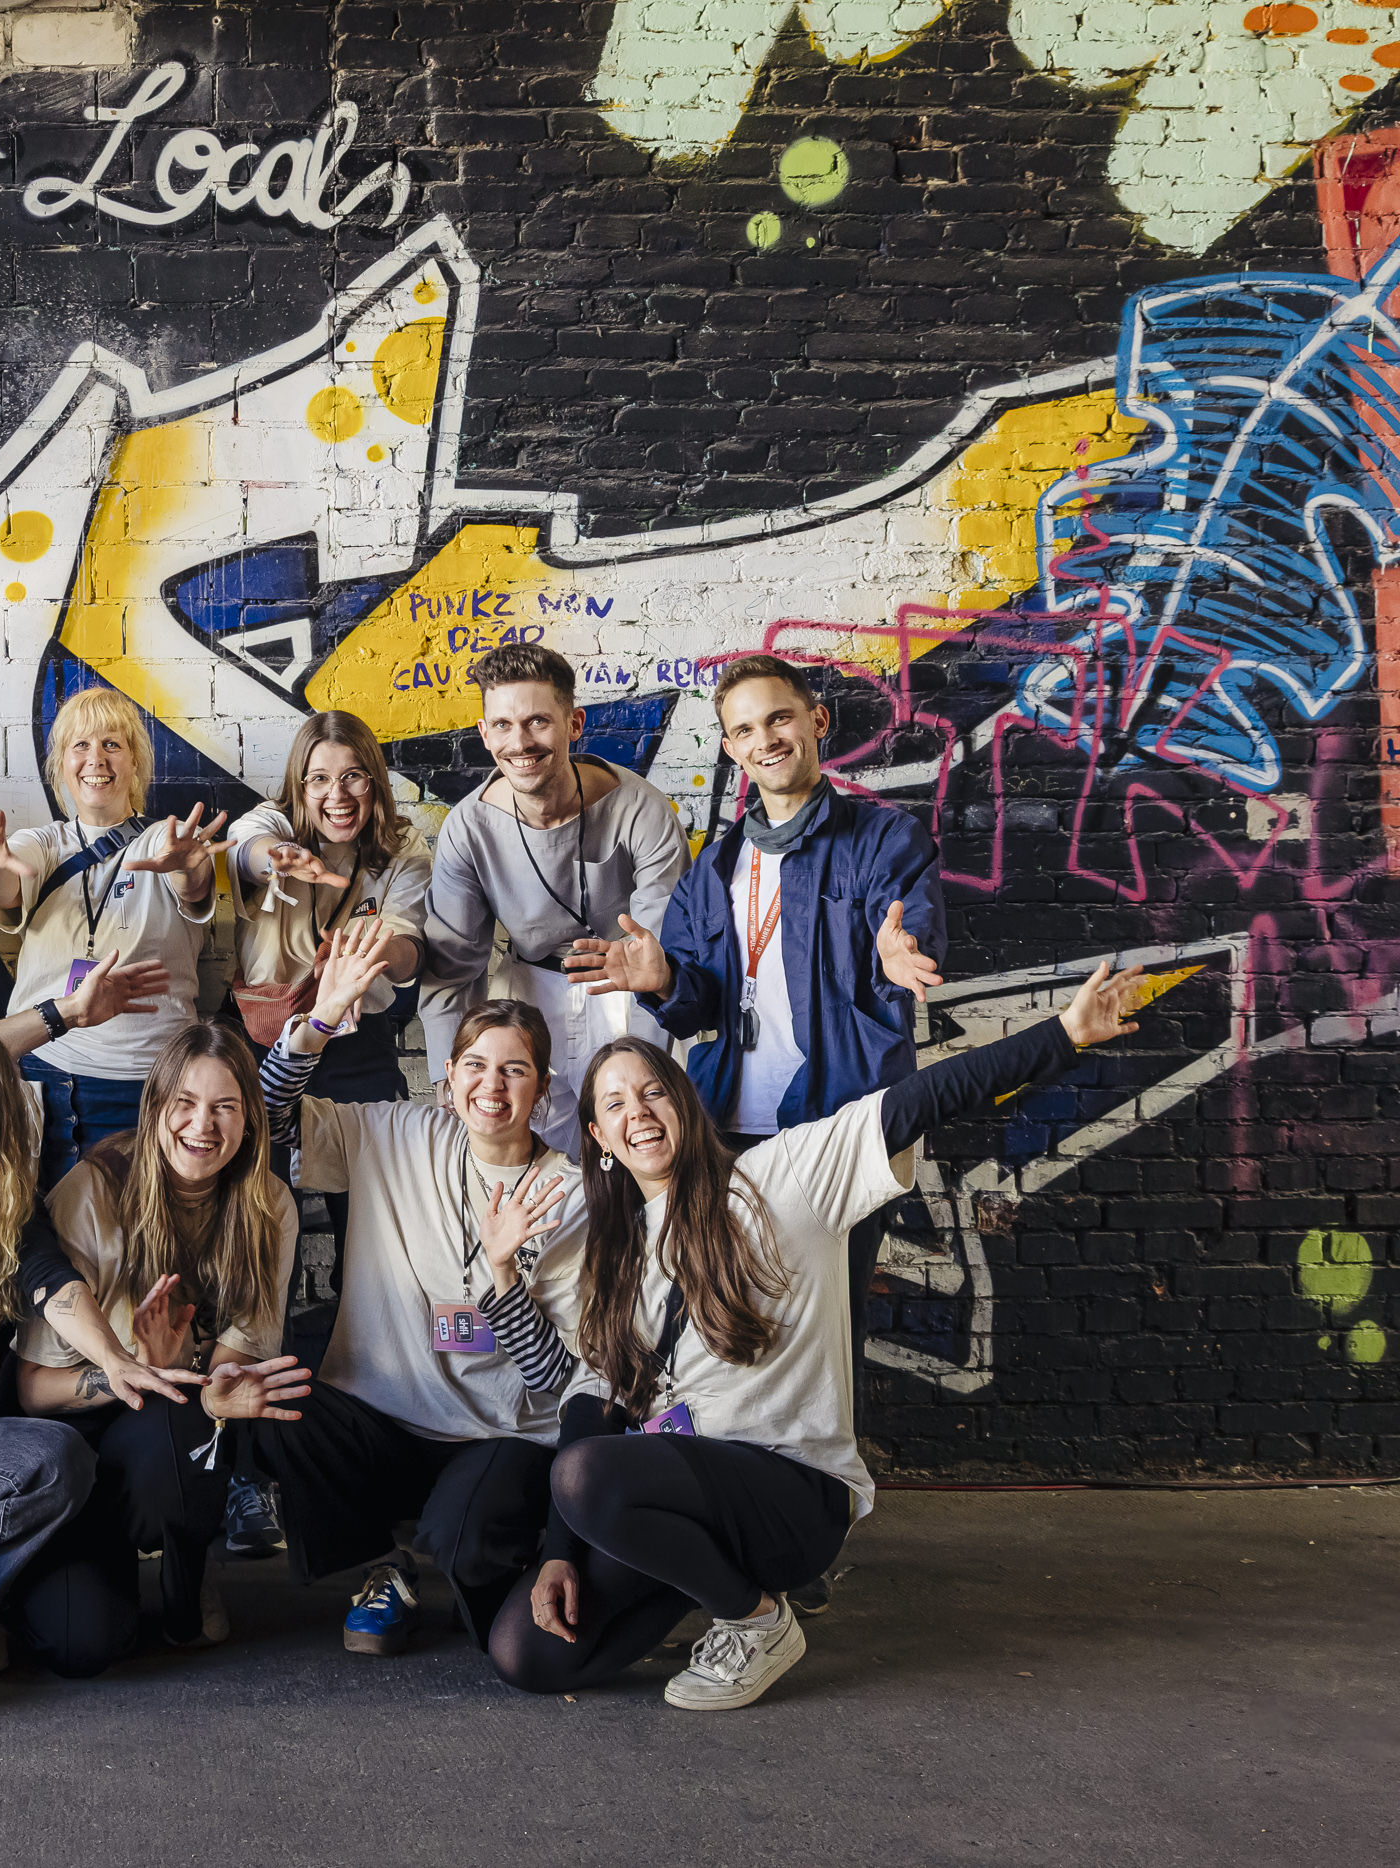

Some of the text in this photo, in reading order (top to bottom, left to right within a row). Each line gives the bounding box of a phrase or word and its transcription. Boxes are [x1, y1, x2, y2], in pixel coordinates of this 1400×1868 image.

[408, 589, 516, 622] PUNKZ
[448, 621, 545, 653] DEAD
[755, 946, 762, 955] 20
[760, 926, 770, 947] JAHRE
